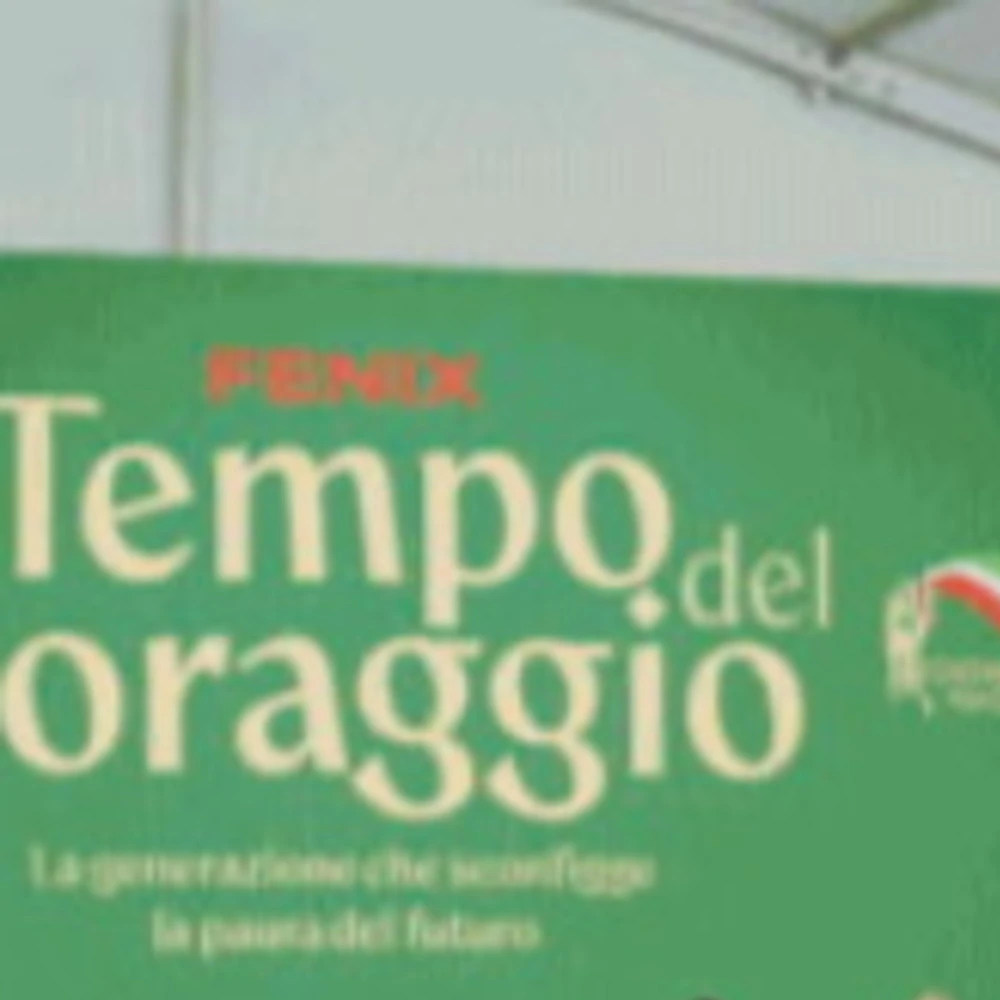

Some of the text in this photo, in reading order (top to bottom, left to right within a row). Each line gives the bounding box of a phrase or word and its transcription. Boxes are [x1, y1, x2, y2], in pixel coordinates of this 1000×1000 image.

[207, 347, 480, 406] FENIX
[0, 394, 830, 629] Tempo del
[0, 588, 806, 822] oraggio
[30, 846, 82, 889] La
[361, 846, 437, 889] che
[151, 907, 191, 951] la
[330, 907, 395, 951] del
